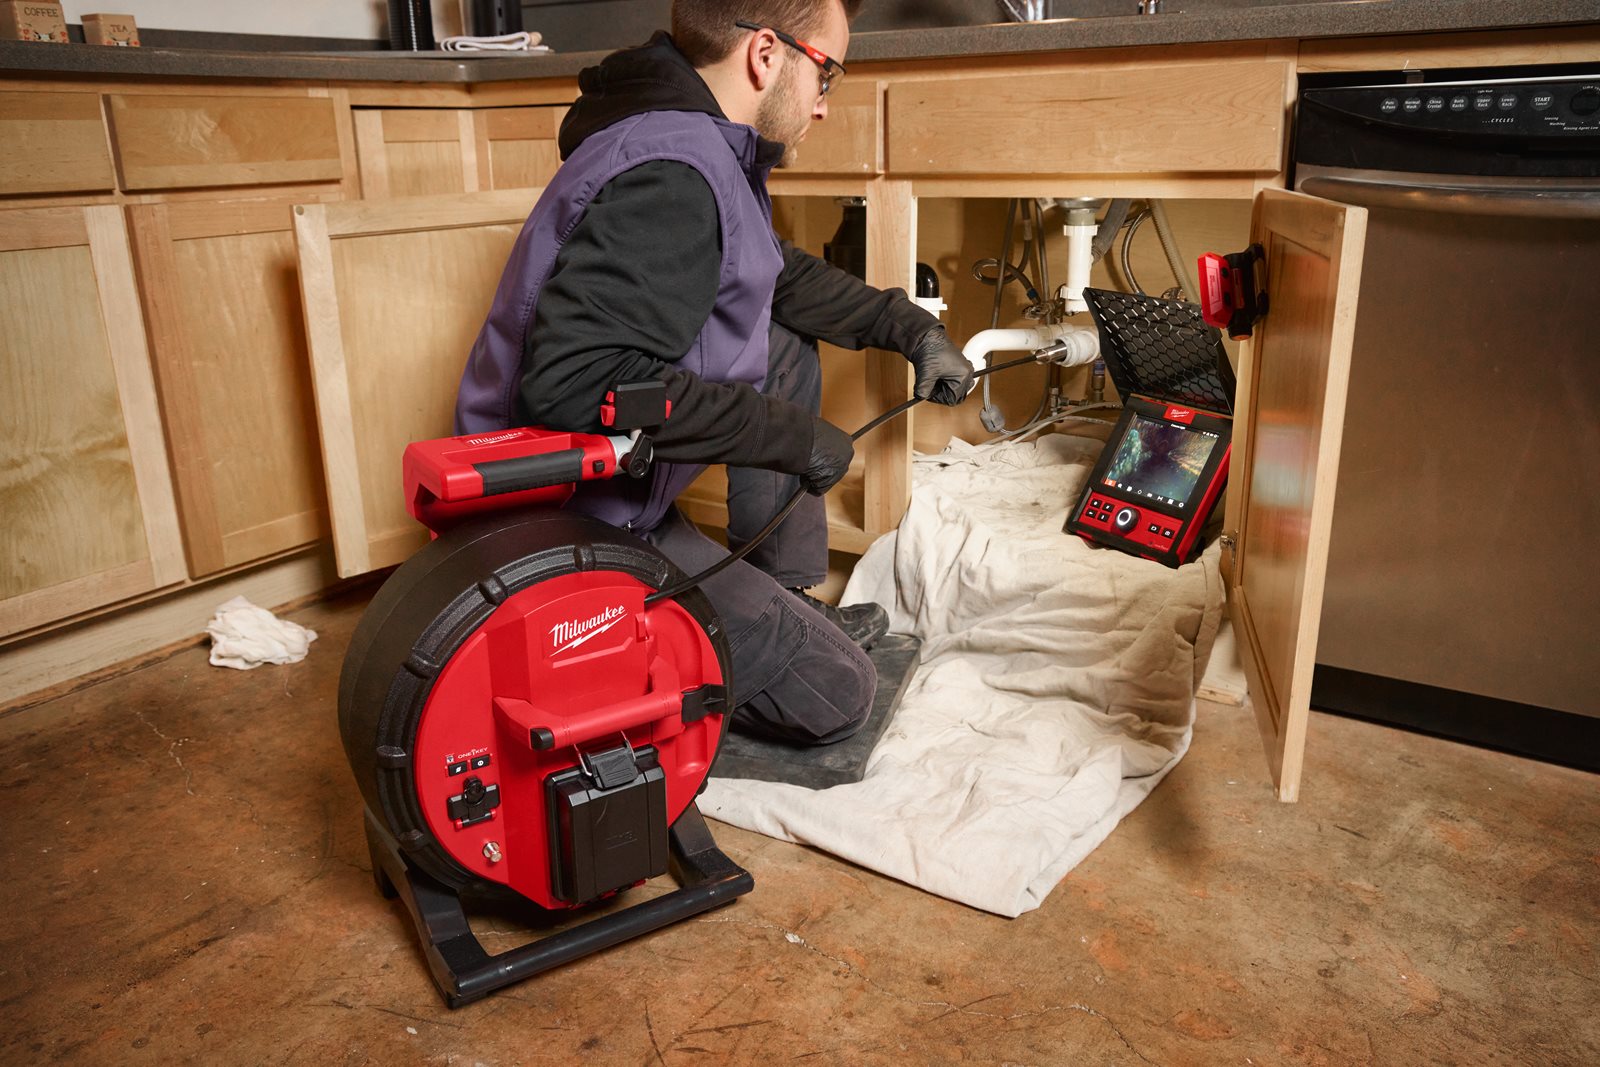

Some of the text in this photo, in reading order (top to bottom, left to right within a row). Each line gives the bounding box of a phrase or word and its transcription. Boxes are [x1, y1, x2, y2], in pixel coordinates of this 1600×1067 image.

[24, 7, 59, 18] COFFEE
[110, 24, 129, 33] TEA
[466, 431, 524, 445] Milwaukee
[548, 605, 626, 648] Milwaukee
